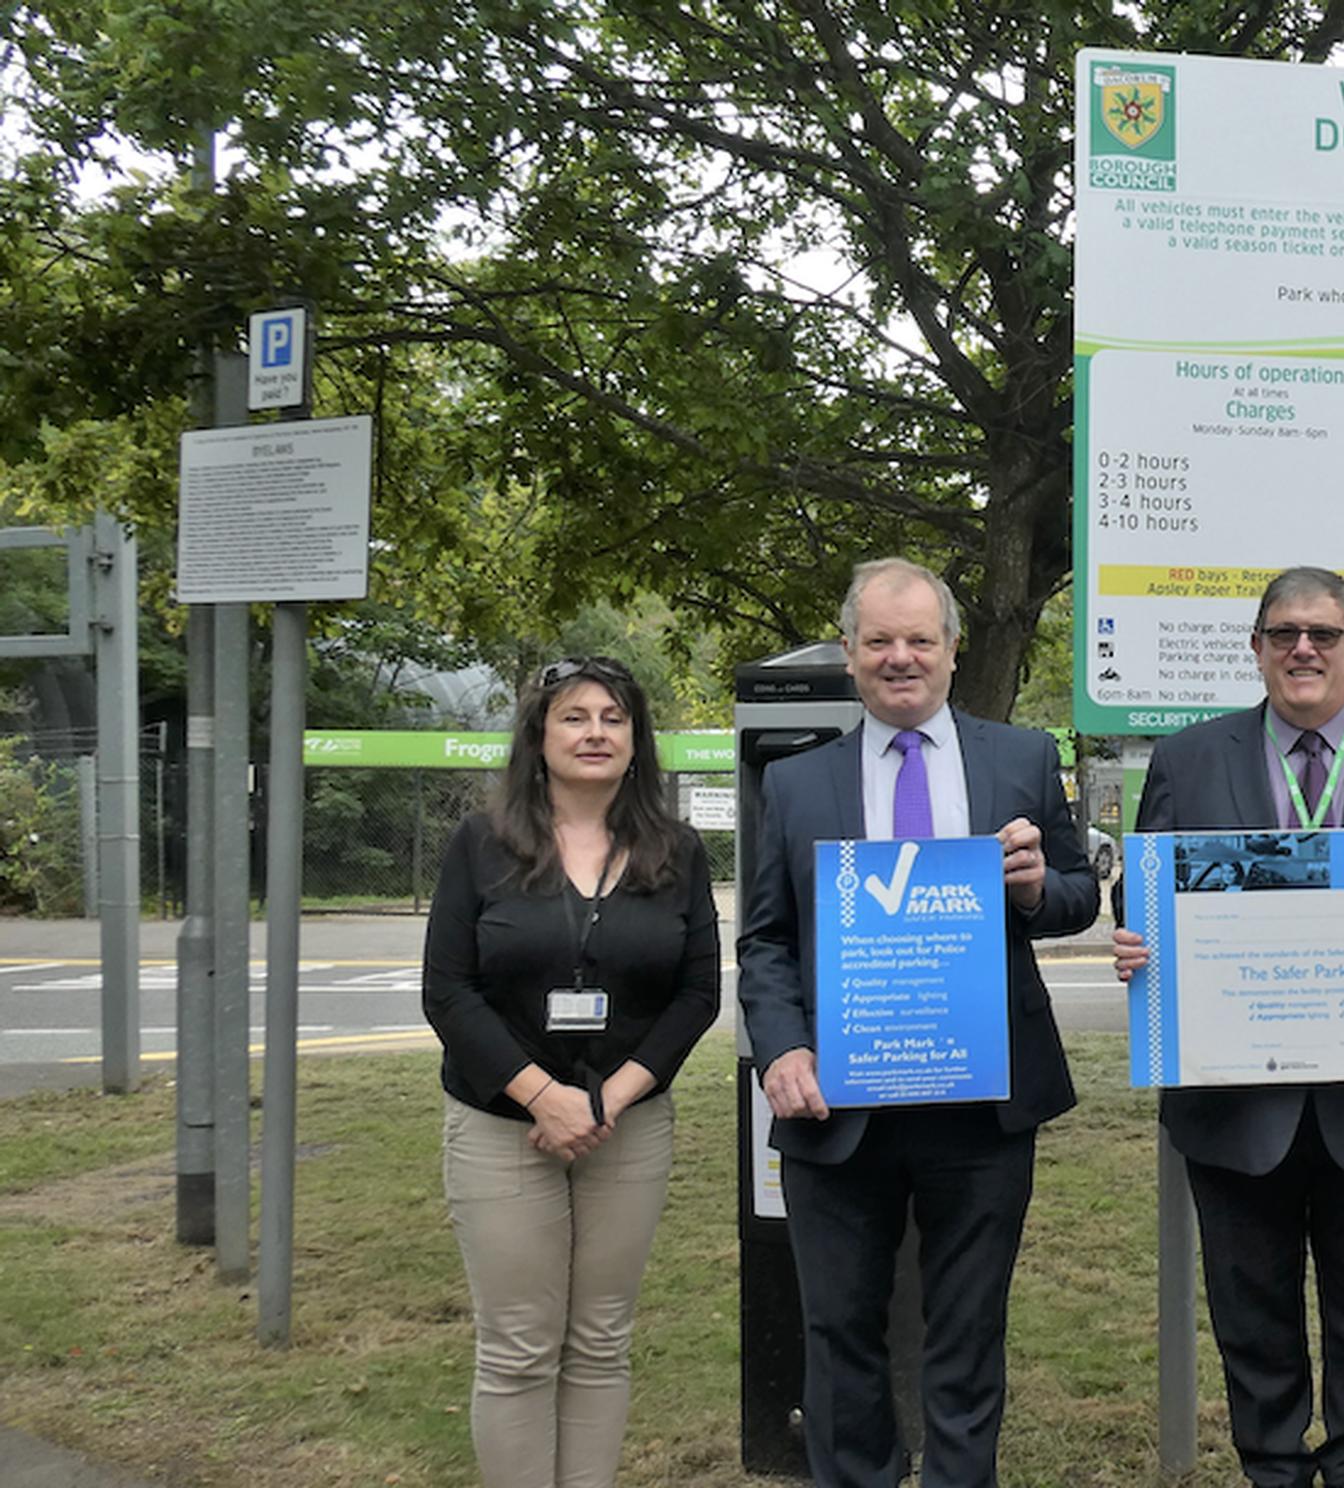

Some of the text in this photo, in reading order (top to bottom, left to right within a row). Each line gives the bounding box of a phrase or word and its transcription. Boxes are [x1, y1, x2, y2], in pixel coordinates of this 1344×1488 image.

[1090, 160, 1176, 174] BOROUGH
[1092, 174, 1174, 190] COUNCIL
[1115, 198, 1135, 213] All
[1142, 200, 1201, 216] vehicles
[1207, 204, 1245, 219] must
[1251, 206, 1290, 221] enter
[1297, 209, 1320, 223] the
[1122, 218, 1131, 229] a
[1138, 217, 1174, 231] valid
[1180, 219, 1255, 239] telephone
[1261, 223, 1325, 243] payment
[1168, 238, 1176, 248] a
[1183, 236, 1218, 250] valid
[1225, 241, 1276, 253] season
[1283, 241, 1324, 256] ticket
[1330, 246, 1344, 257] or
[1277, 286, 1312, 302] Park
[268, 323, 288, 363] P
[1176, 361, 1344, 385] Hours of operation
[1234, 387, 1289, 400] At all times
[1225, 400, 1296, 423] Charges
[1138, 454, 1190, 471] hours
[1098, 474, 1128, 489] 2-3
[1136, 474, 1187, 491] hours
[1098, 494, 1130, 509] 3-4
[1141, 494, 1192, 511] hours
[1098, 514, 1138, 530] 4-10
[1146, 515, 1199, 532] hours
[1168, 568, 1194, 581] RED
[1198, 570, 1228, 582] bays
[1148, 583, 1191, 596] Apsley
[1194, 584, 1231, 596] Paper
[1158, 622, 1174, 632] No
[1158, 638, 1246, 650] Electric vehicles
[1158, 652, 1200, 664] Parking
[1203, 653, 1240, 664] charge
[1158, 670, 1174, 680] No
[1178, 670, 1216, 682] charge
[1220, 670, 1231, 680] in
[1158, 690, 1174, 700] No
[1128, 712, 1199, 727] SECURITY
[686, 749, 711, 760] THE
[910, 884, 976, 898] PARK
[906, 898, 982, 914] MARK
[1238, 966, 1268, 980] The
[1274, 965, 1310, 980] Safer
[851, 978, 888, 988] Quality
[852, 1024, 882, 1034] Clean
[873, 1038, 935, 1050] Park Mark
[848, 1048, 968, 1064] Safer Parking for All
